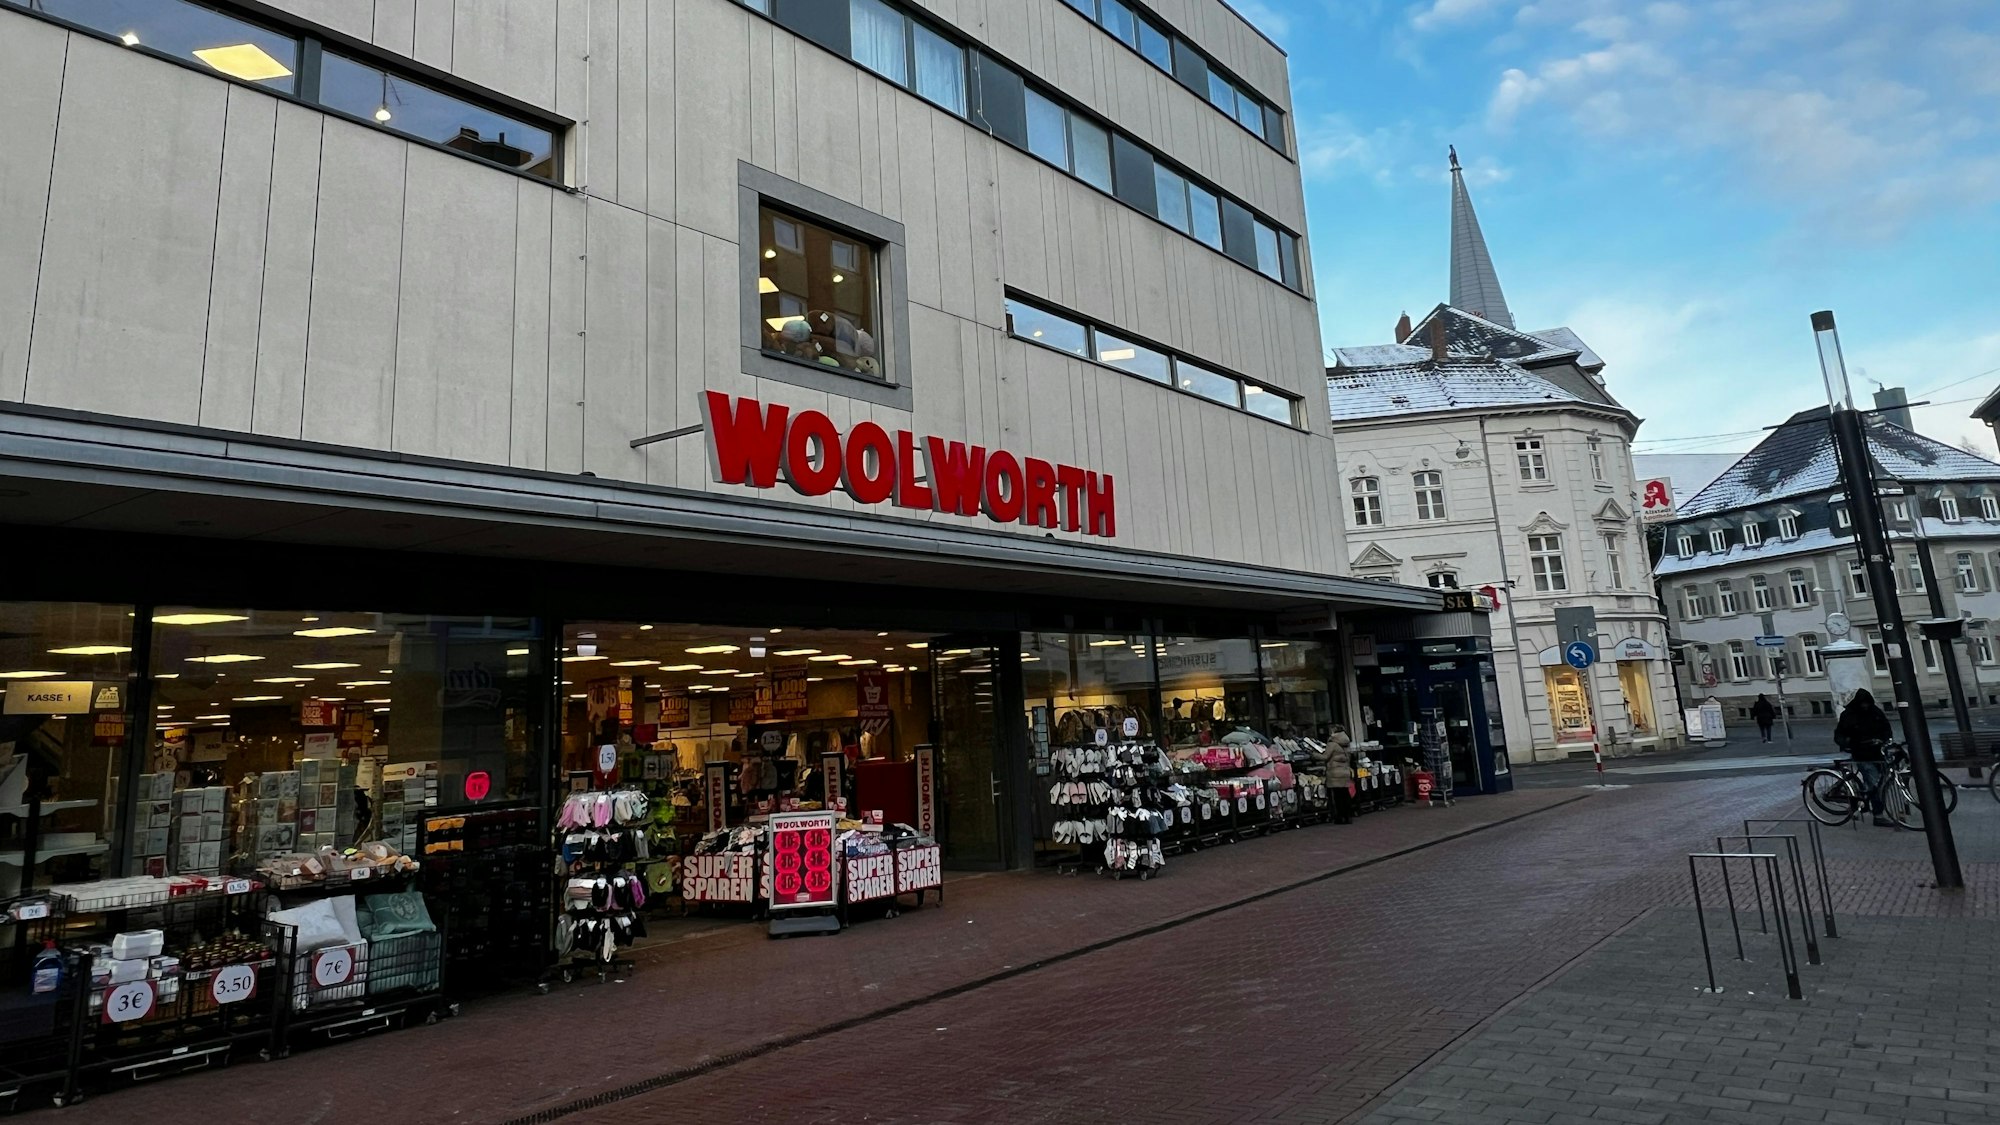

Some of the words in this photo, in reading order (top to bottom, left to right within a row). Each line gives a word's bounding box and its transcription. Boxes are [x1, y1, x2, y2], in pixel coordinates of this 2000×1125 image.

[699, 389, 1116, 538] WOOLWORTH
[1444, 594, 1468, 609] SK
[27, 693, 64, 703] KASSE
[67, 693, 72, 702] 1
[774, 819, 831, 829] WOOLWORTH
[683, 855, 753, 879] SUPER
[848, 854, 894, 880] SUPER
[897, 846, 940, 871] SUPER
[682, 878, 753, 903] SPAREN
[849, 874, 895, 902] SPAREN
[899, 865, 942, 892] SPAREN
[324, 960, 344, 976] 7€
[217, 975, 251, 995] 3.50
[118, 993, 144, 1013] 3€
